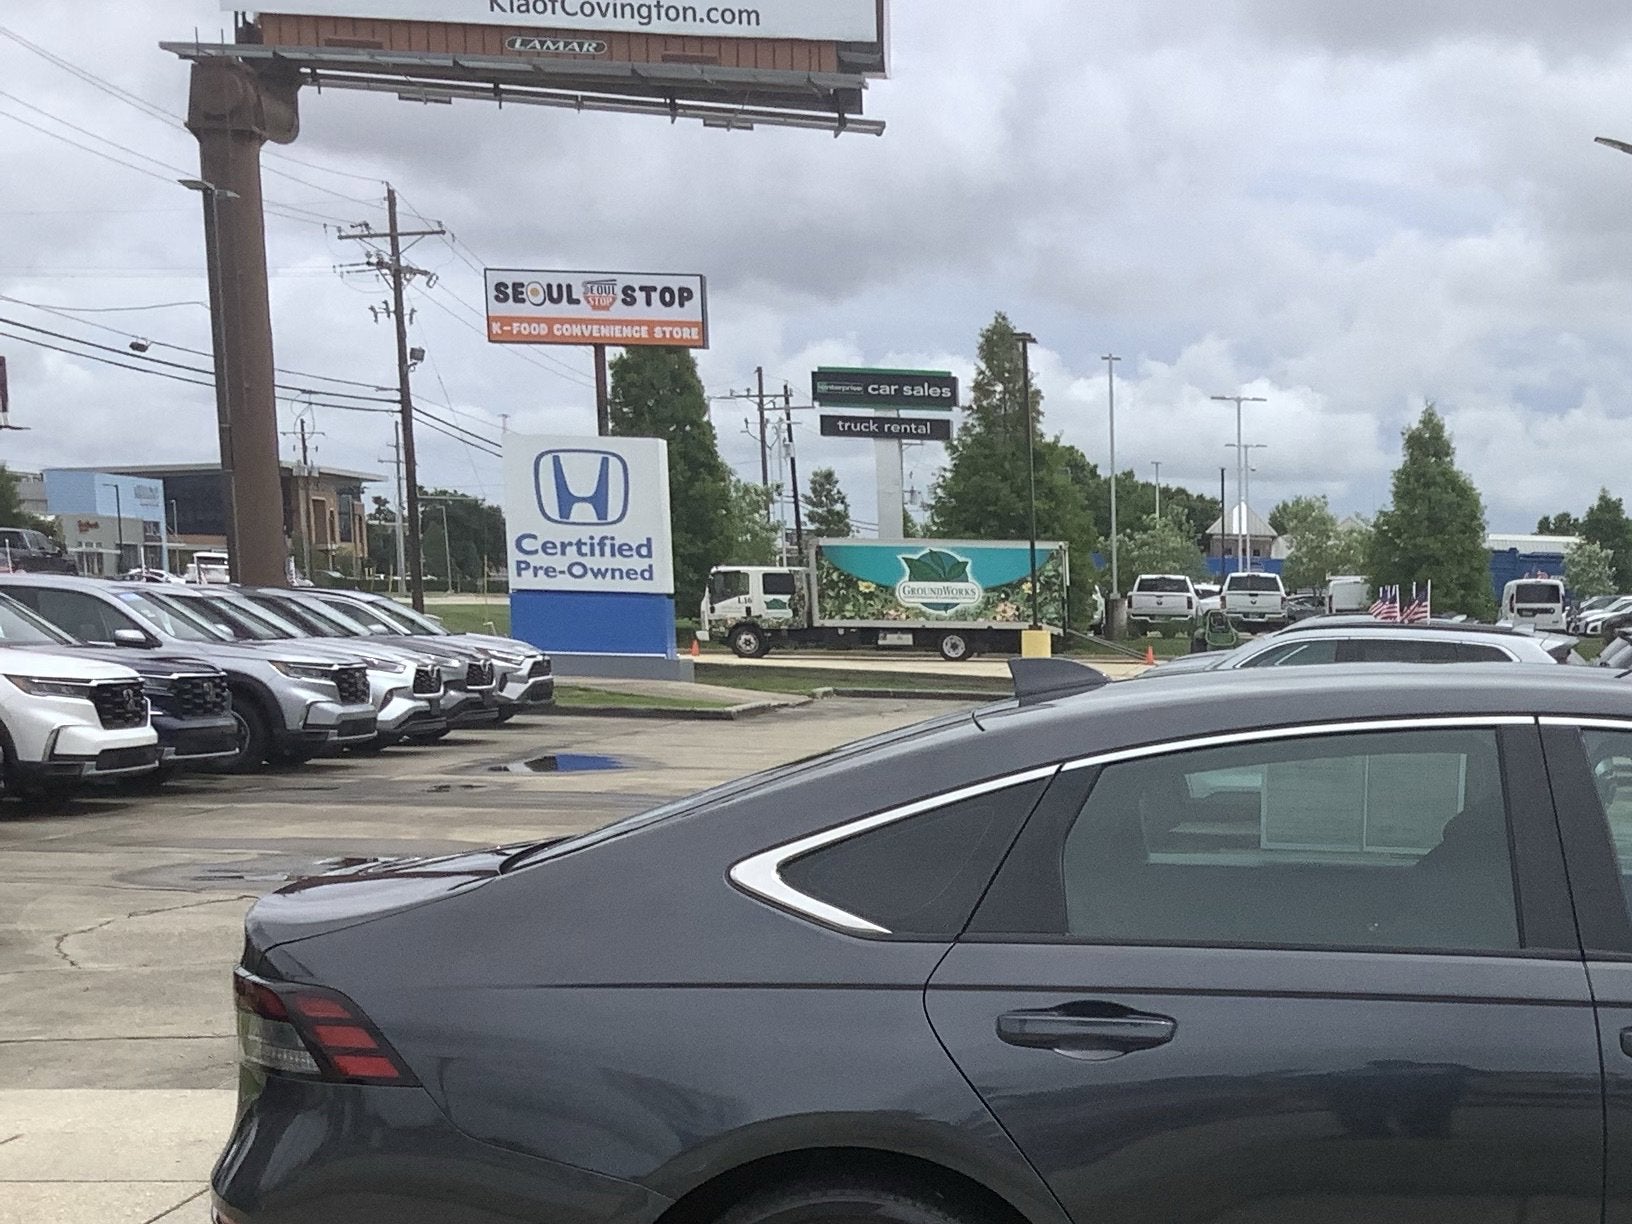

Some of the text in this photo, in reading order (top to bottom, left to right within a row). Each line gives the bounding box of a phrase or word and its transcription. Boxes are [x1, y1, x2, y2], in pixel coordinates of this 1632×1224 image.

[514, 38, 598, 53] LAMAR
[494, 281, 694, 308] SEOUL STOP
[491, 321, 699, 339] K-FOOD CONVENIENCE STORE
[867, 382, 952, 398] car sales
[837, 419, 931, 434] truck rental
[514, 533, 653, 559] Certified
[515, 560, 654, 581] Pre-Owned
